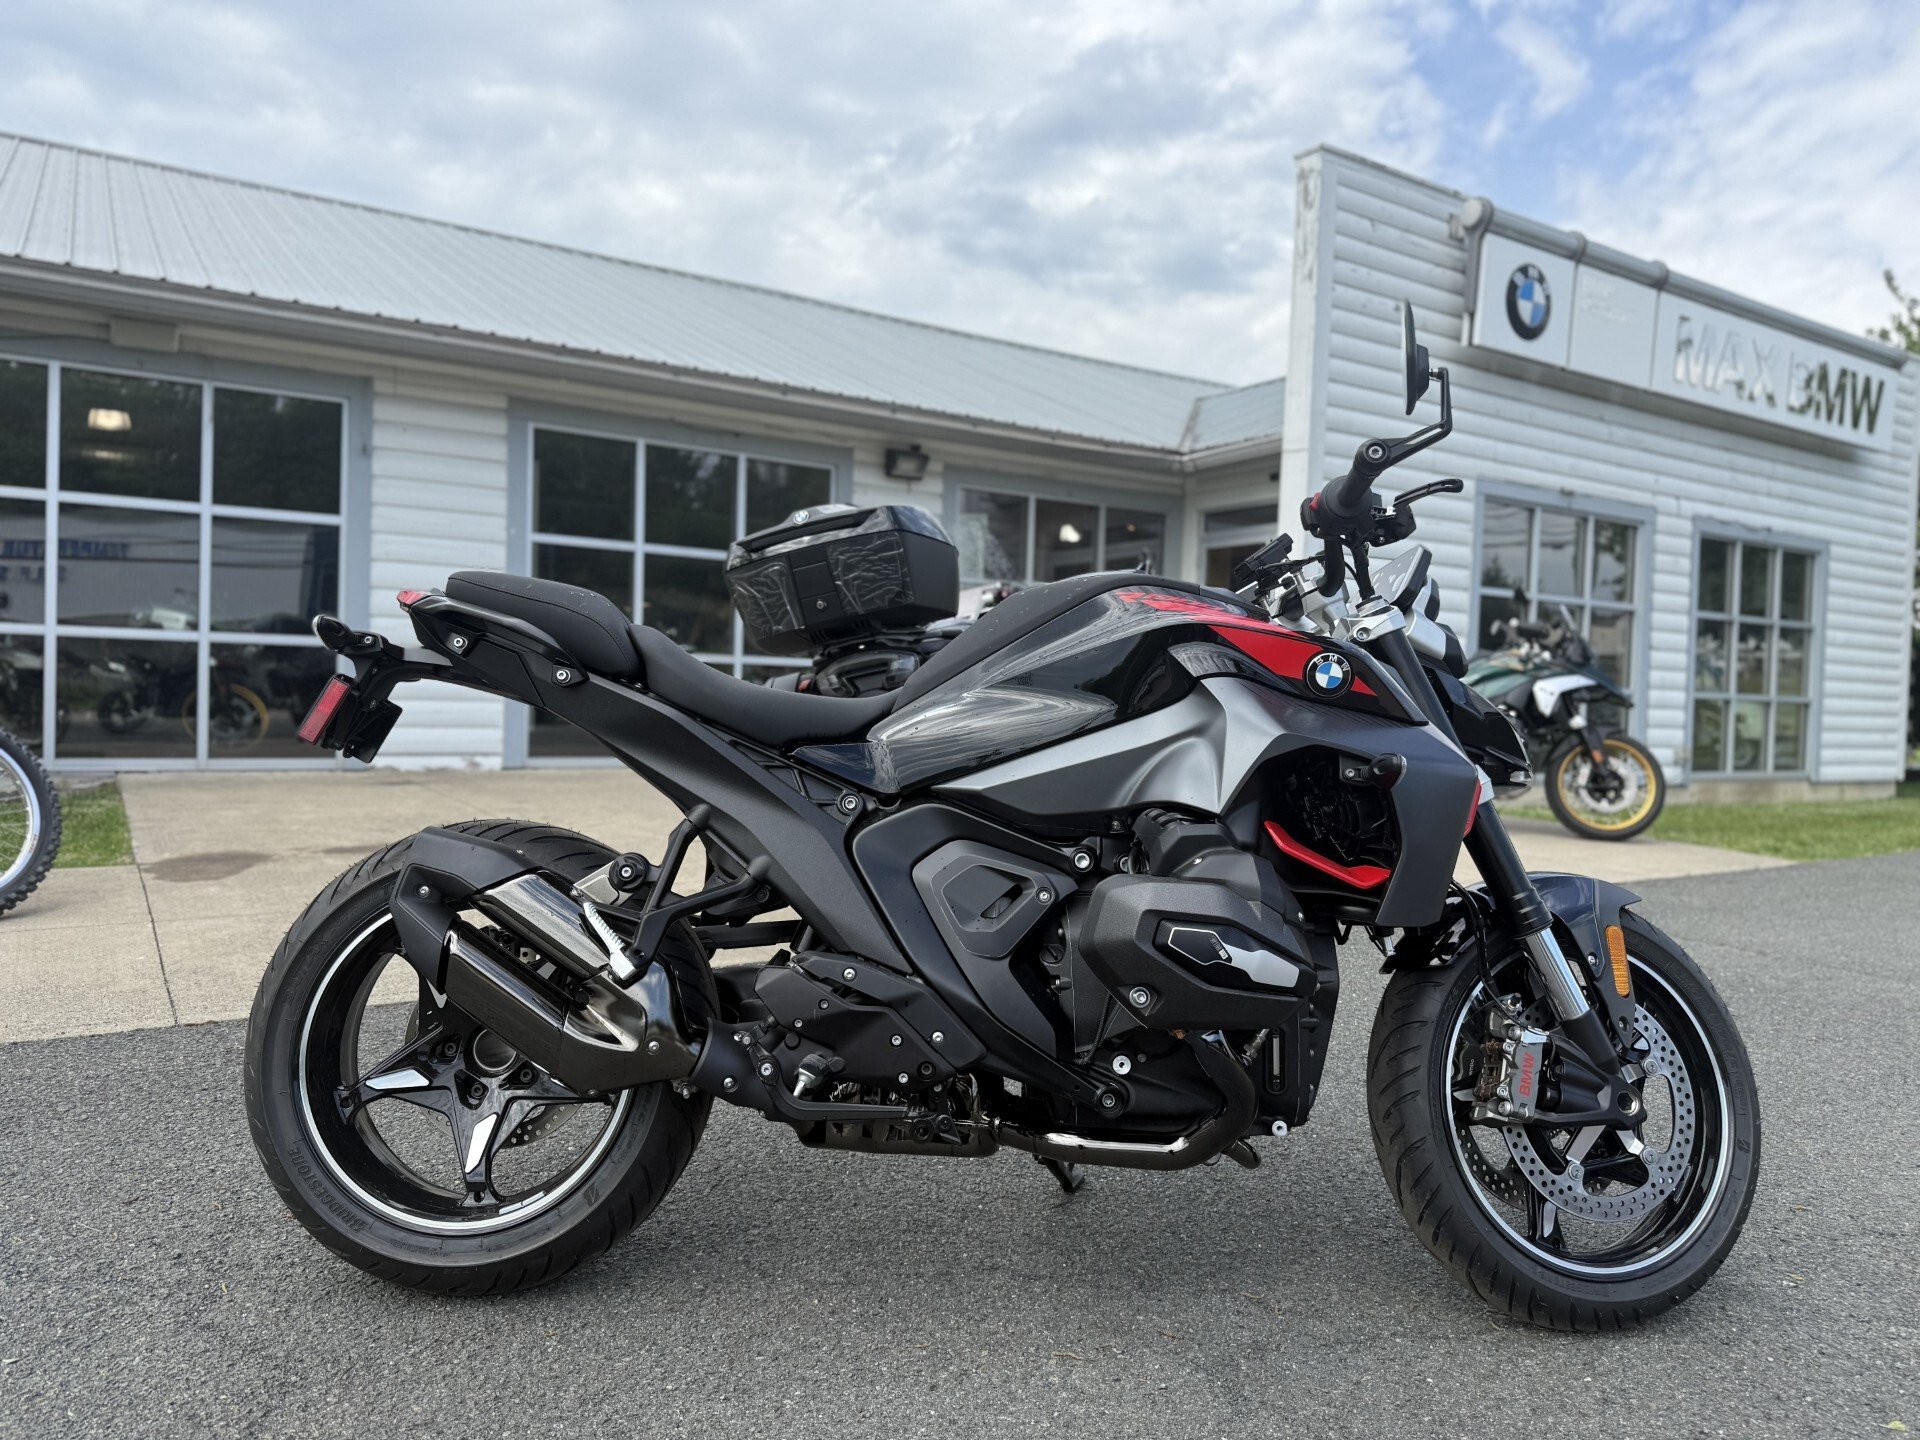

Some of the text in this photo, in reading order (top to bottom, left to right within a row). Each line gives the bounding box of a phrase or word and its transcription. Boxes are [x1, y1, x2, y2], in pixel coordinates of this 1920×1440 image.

[1673, 314, 1885, 435] MAX BMW
[1315, 653, 1350, 672] BMW
[1519, 1053, 1535, 1097] BMW
[287, 1148, 367, 1234] BRIDGESTONE
